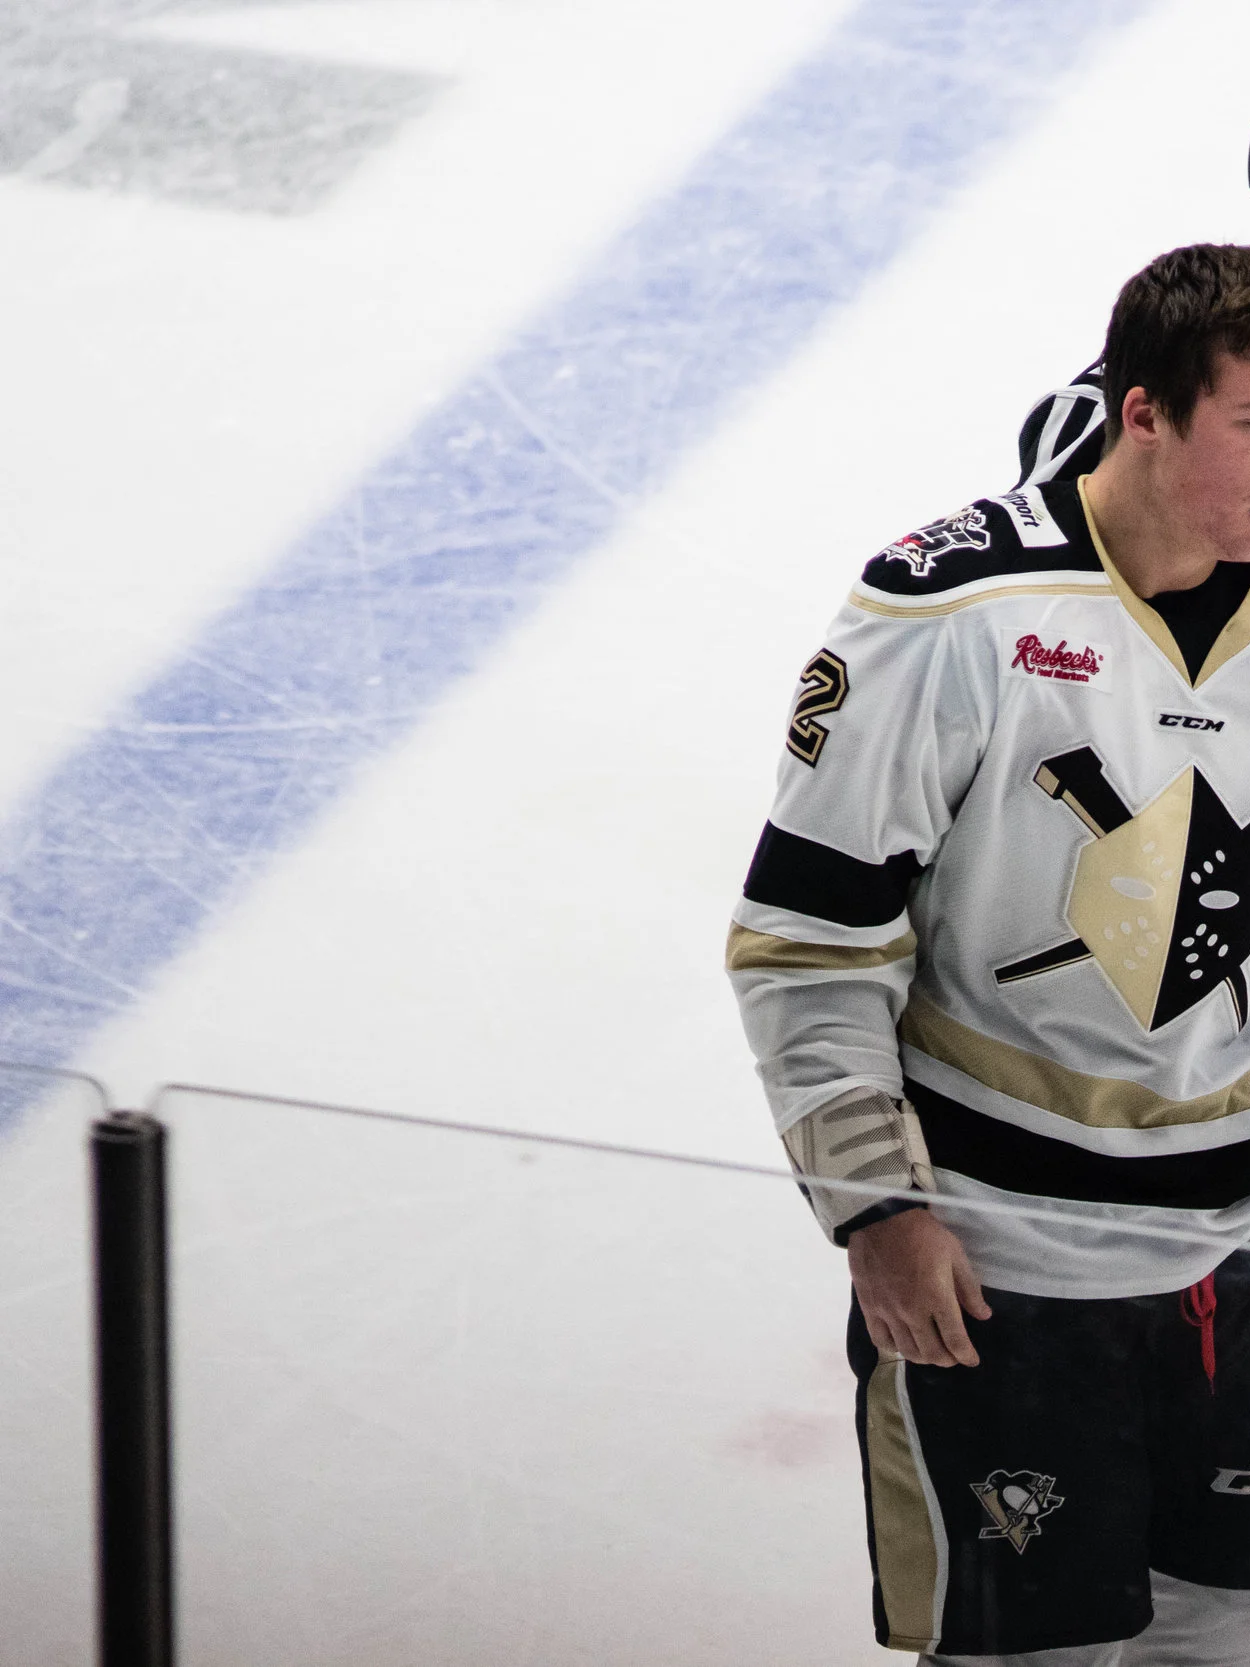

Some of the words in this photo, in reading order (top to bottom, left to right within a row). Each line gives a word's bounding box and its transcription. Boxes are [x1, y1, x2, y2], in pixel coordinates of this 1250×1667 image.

[1011, 634, 1100, 675] Riesbeck's
[786, 647, 850, 768] 2
[1159, 713, 1225, 732] CCM
